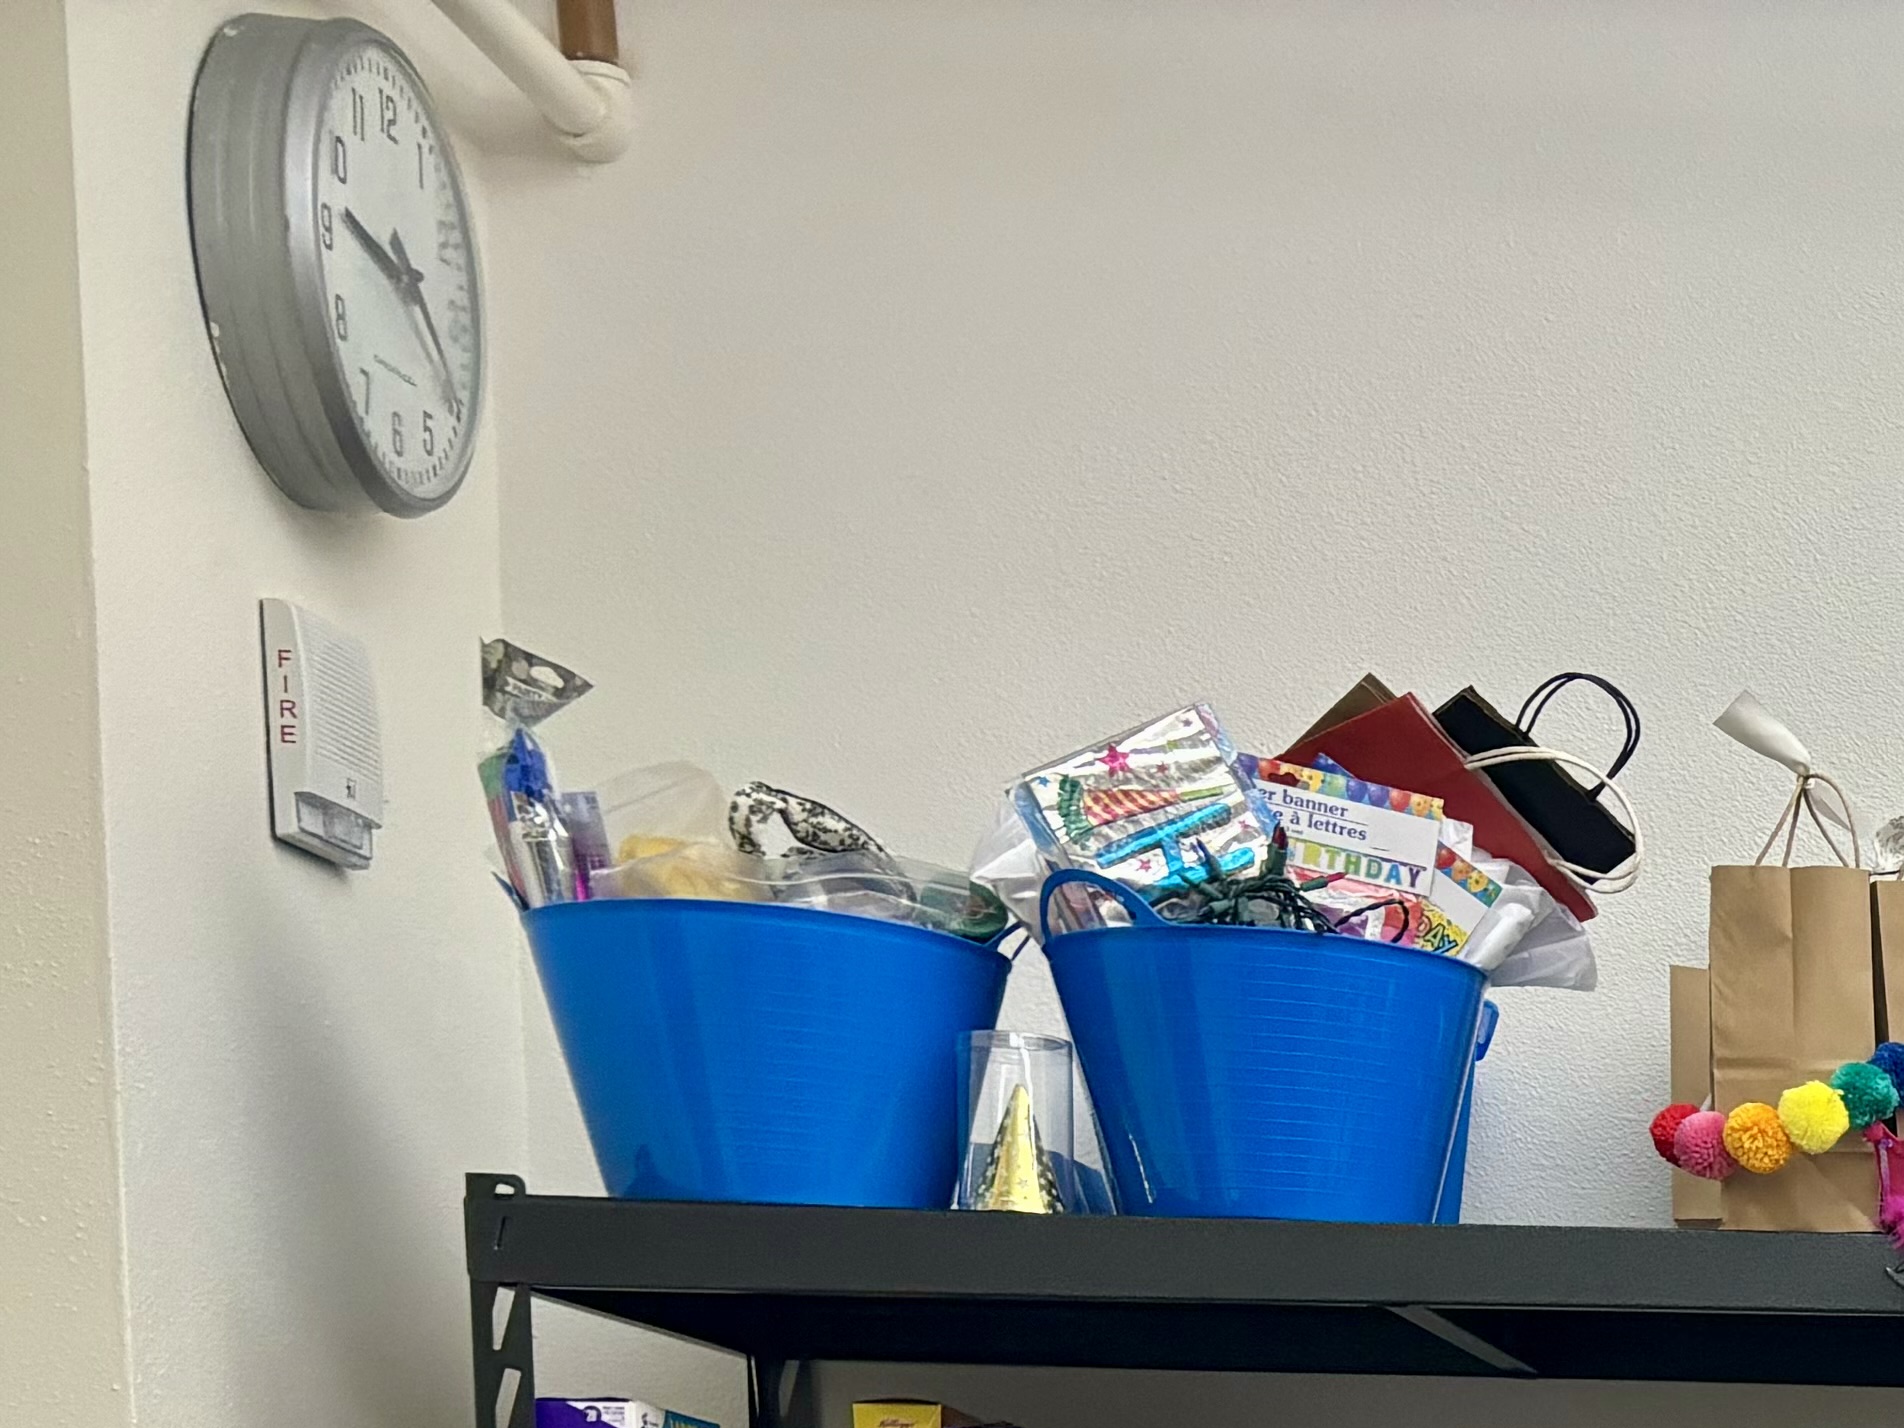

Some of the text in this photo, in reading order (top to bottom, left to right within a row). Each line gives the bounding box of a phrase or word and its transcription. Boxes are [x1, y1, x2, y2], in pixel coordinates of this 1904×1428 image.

[352, 87, 365, 141] 11
[379, 87, 398, 145] 12
[423, 410, 435, 456] 5
[278, 650, 297, 744] FIRE
[1283, 789, 1348, 817] banner
[1291, 811, 1367, 840] à lettres
